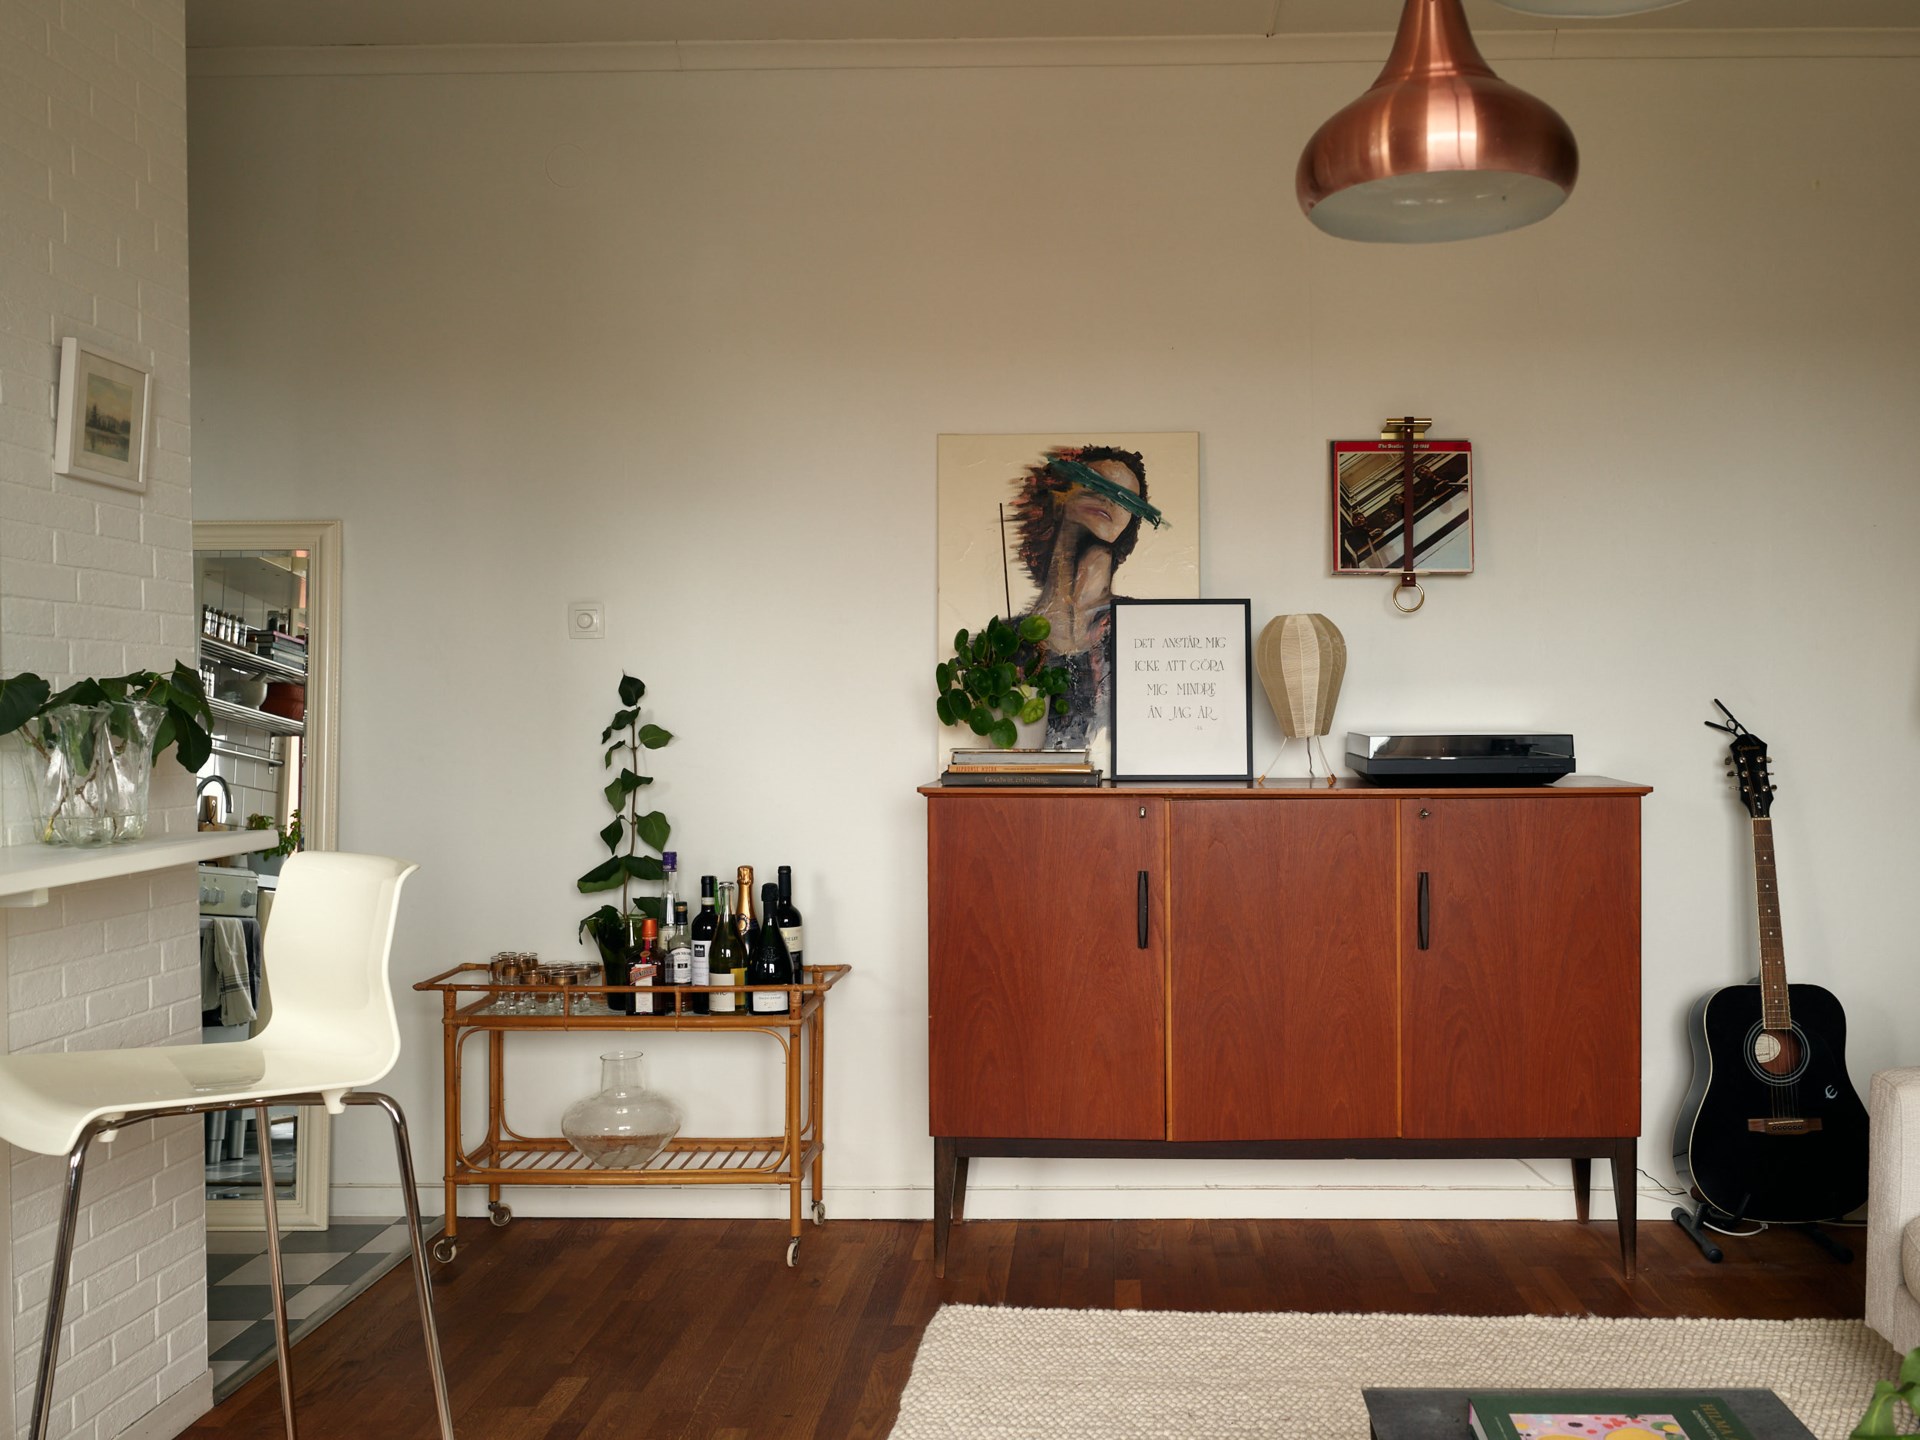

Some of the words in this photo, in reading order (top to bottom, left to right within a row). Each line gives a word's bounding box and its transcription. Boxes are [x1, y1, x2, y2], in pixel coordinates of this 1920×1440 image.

[1134, 638, 1155, 649] DET
[1162, 635, 1203, 649] ANSTÅR
[1205, 637, 1227, 649] MIG
[1134, 659, 1160, 671] ICKE
[1165, 659, 1187, 671] ATT
[1189, 658, 1225, 672] GÖRA
[1146, 683, 1168, 696] MIG
[1176, 682, 1217, 697] MINDRE
[1168, 705, 1192, 721] JAG
